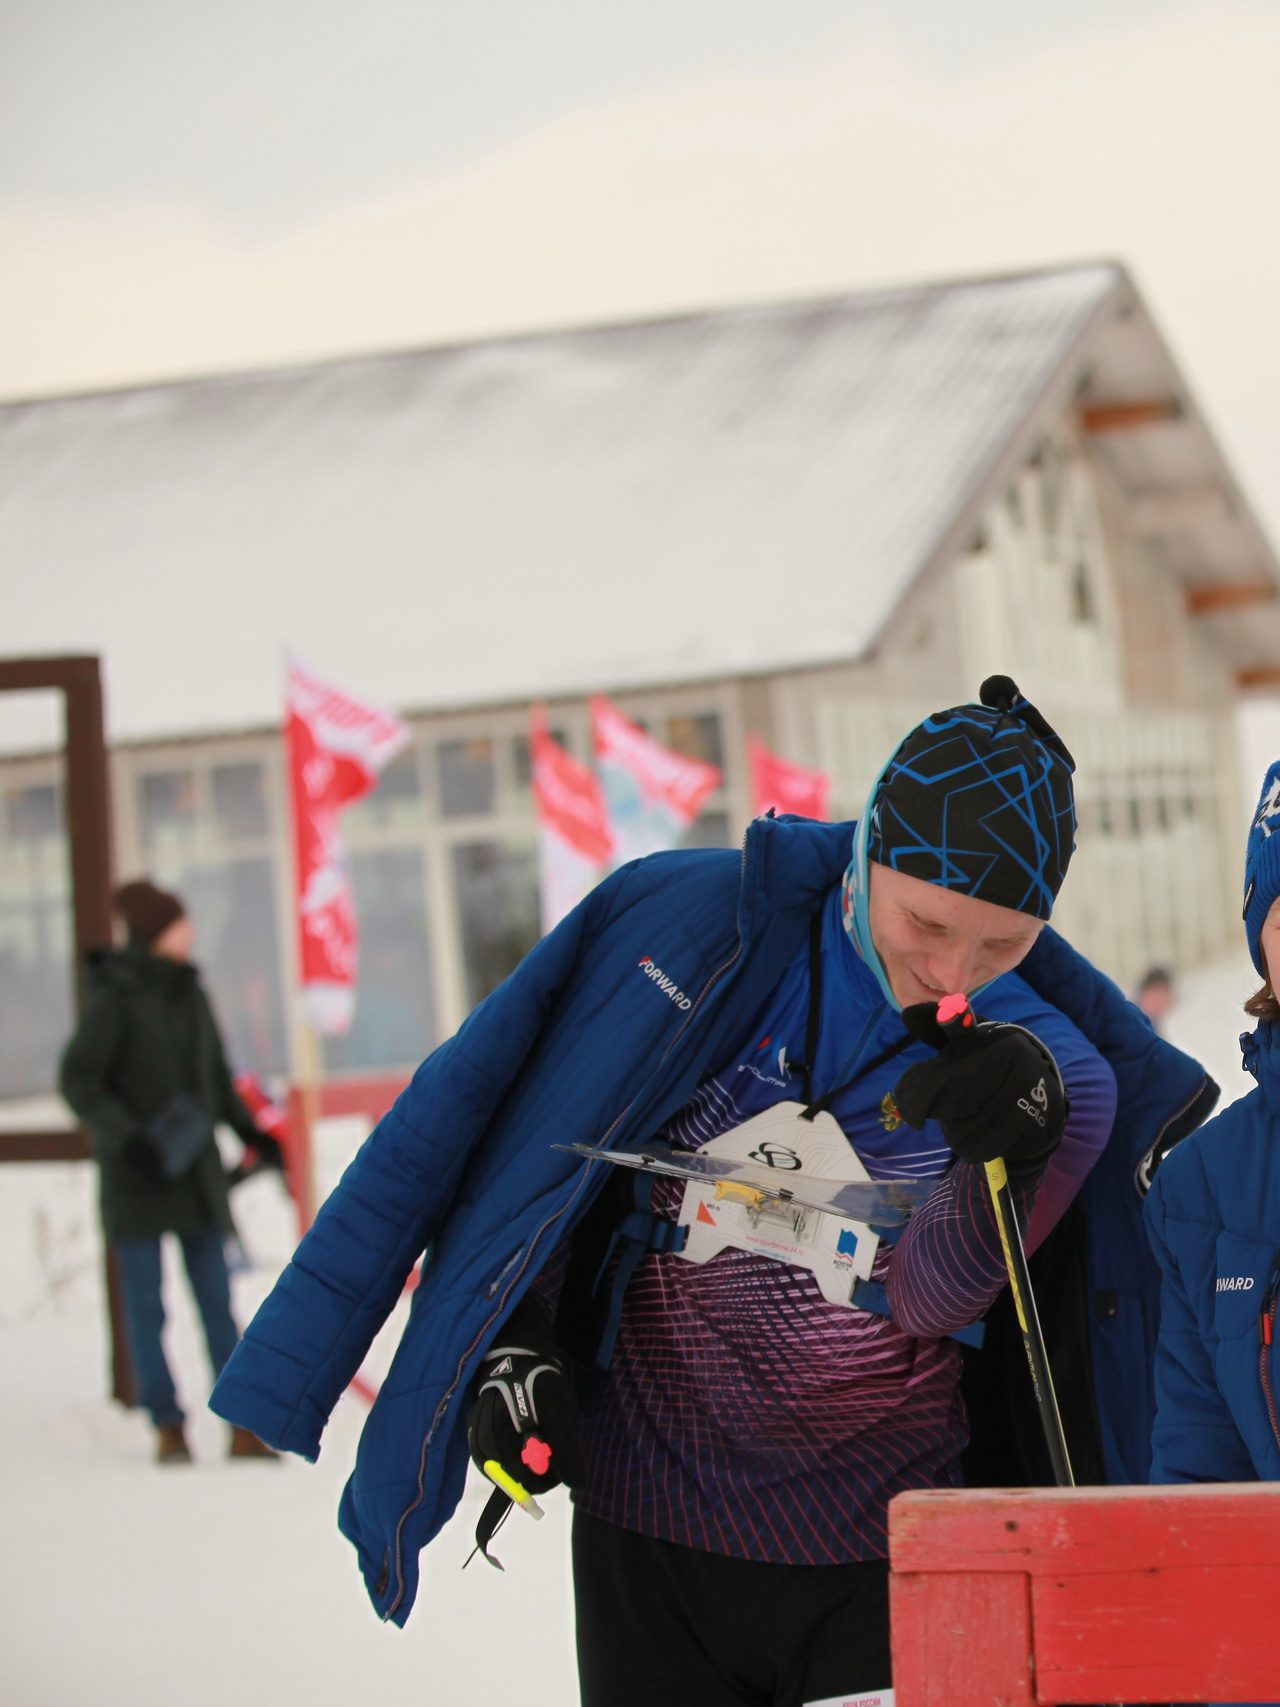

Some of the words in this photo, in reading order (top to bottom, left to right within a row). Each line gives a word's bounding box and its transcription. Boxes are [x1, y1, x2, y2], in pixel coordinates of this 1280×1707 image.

[638, 956, 692, 1010] FORWARD
[1017, 1098, 1046, 1127] odlo
[1215, 1276, 1255, 1293] WARD
